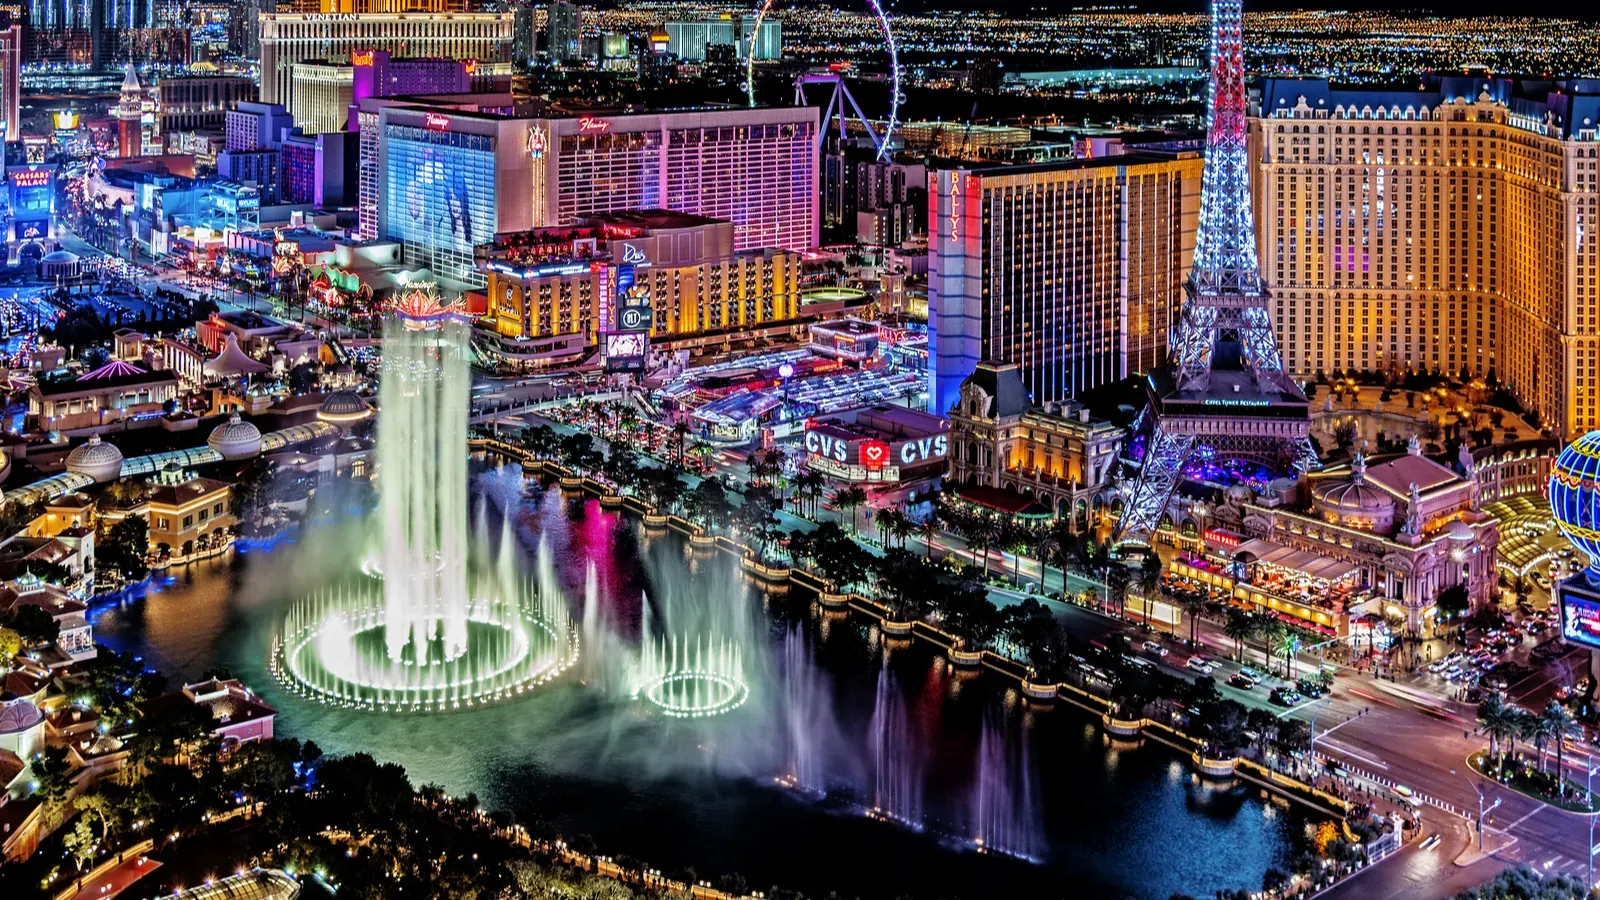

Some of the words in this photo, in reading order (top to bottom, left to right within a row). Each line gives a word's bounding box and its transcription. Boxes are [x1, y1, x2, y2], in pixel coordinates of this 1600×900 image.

[14, 172, 49, 180] CAESARS
[16, 179, 48, 187] PALACE
[805, 431, 847, 462] CVS
[901, 434, 948, 464] CVS
[1204, 531, 1221, 542] BEER
[1221, 536, 1238, 547] PARK
